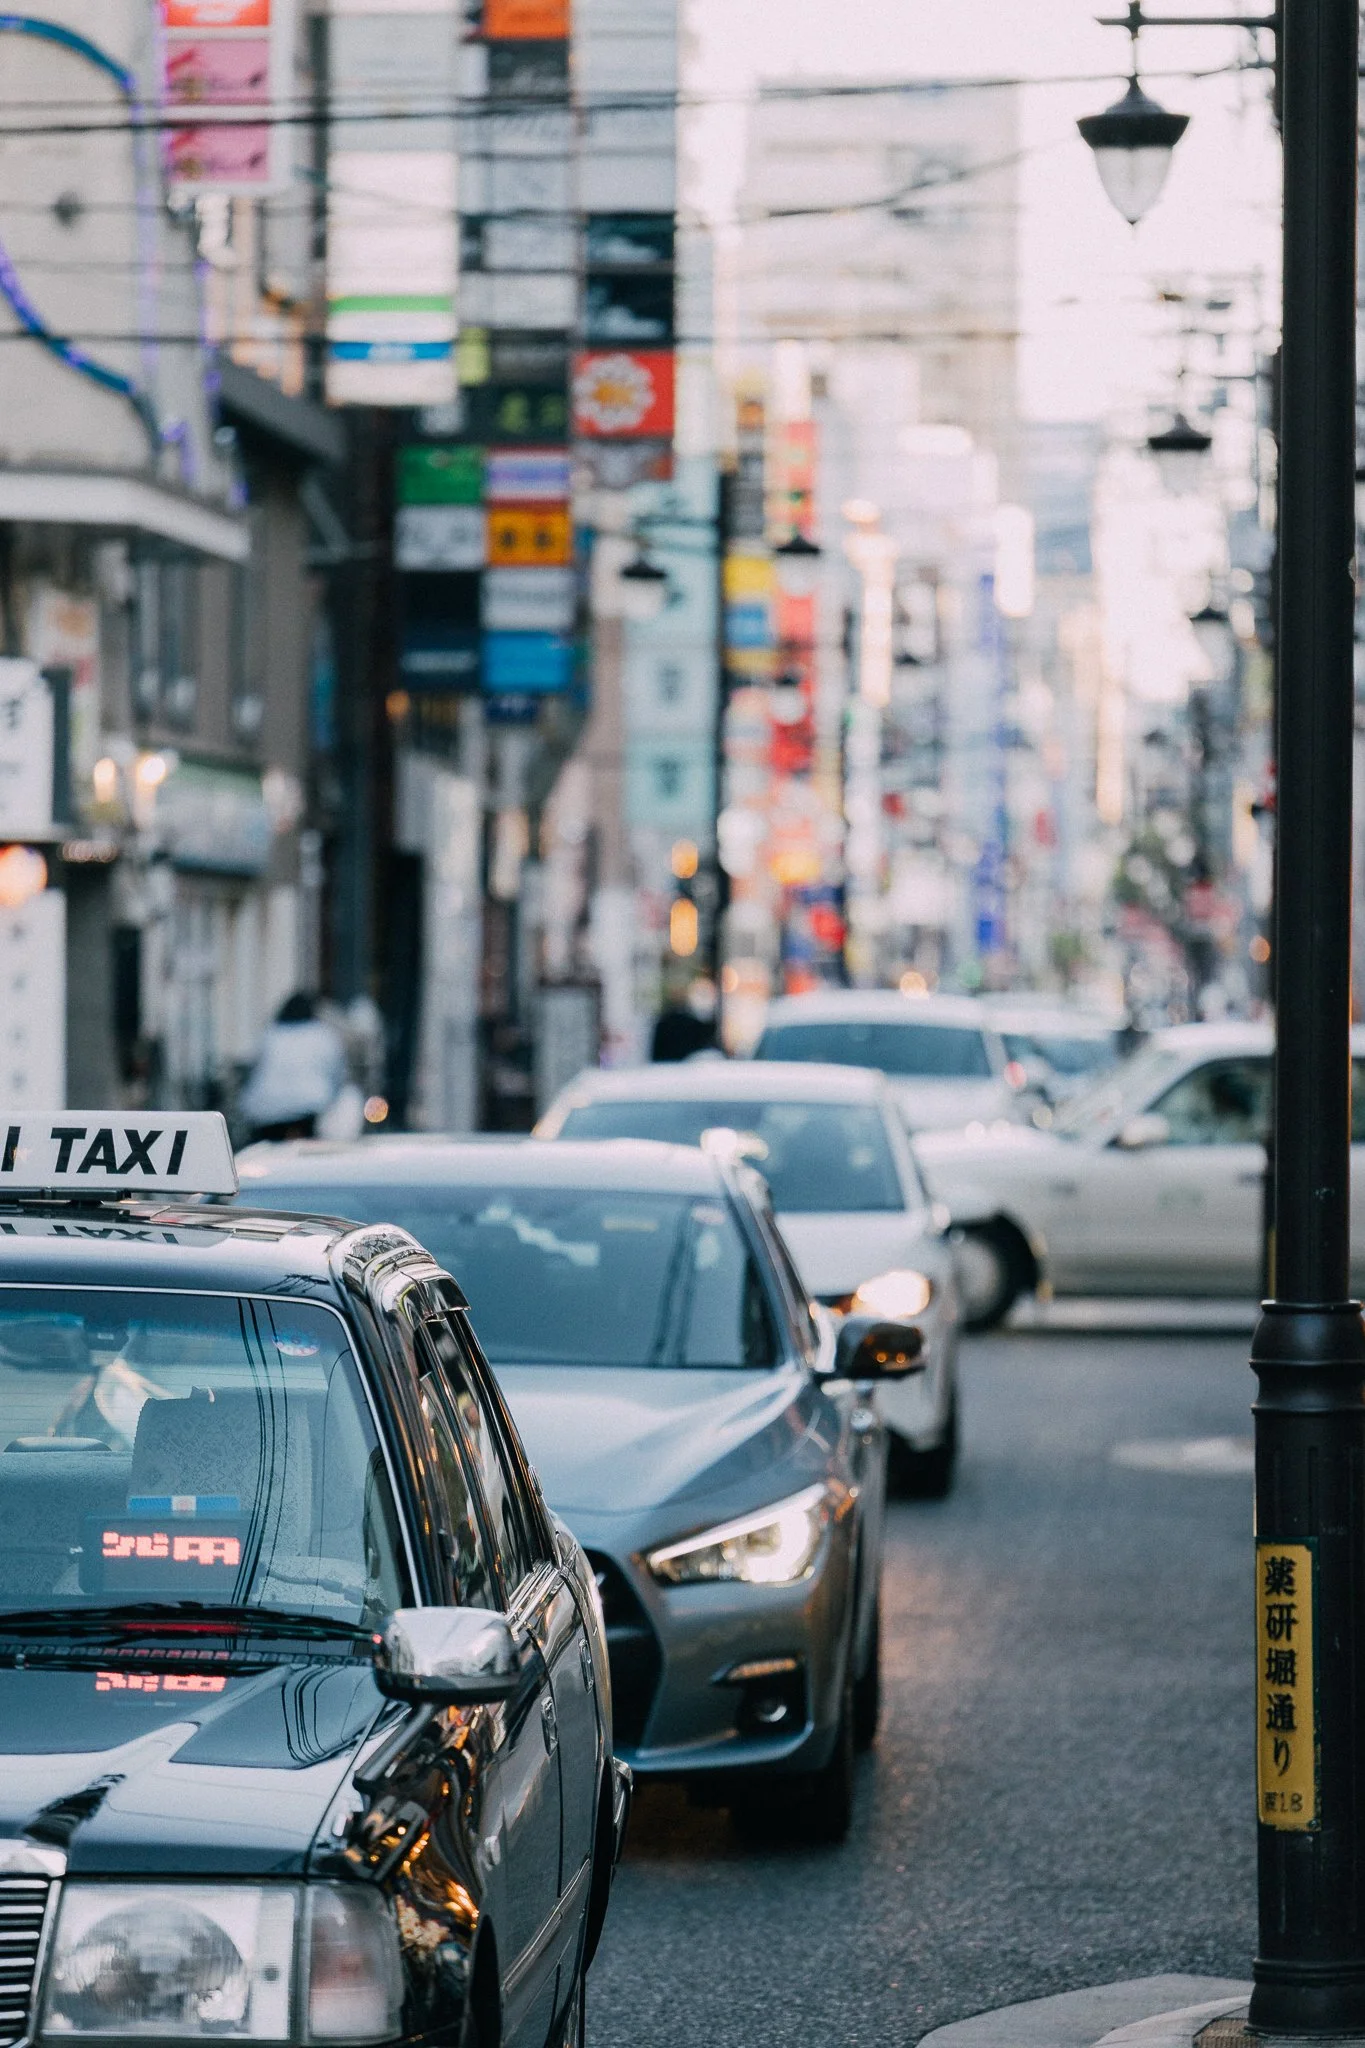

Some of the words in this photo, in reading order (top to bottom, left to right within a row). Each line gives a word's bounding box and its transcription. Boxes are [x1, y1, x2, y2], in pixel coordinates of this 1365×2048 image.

[50, 1127, 188, 1175] TAXI
[1264, 1556, 1298, 1777] 薬研堀通り
